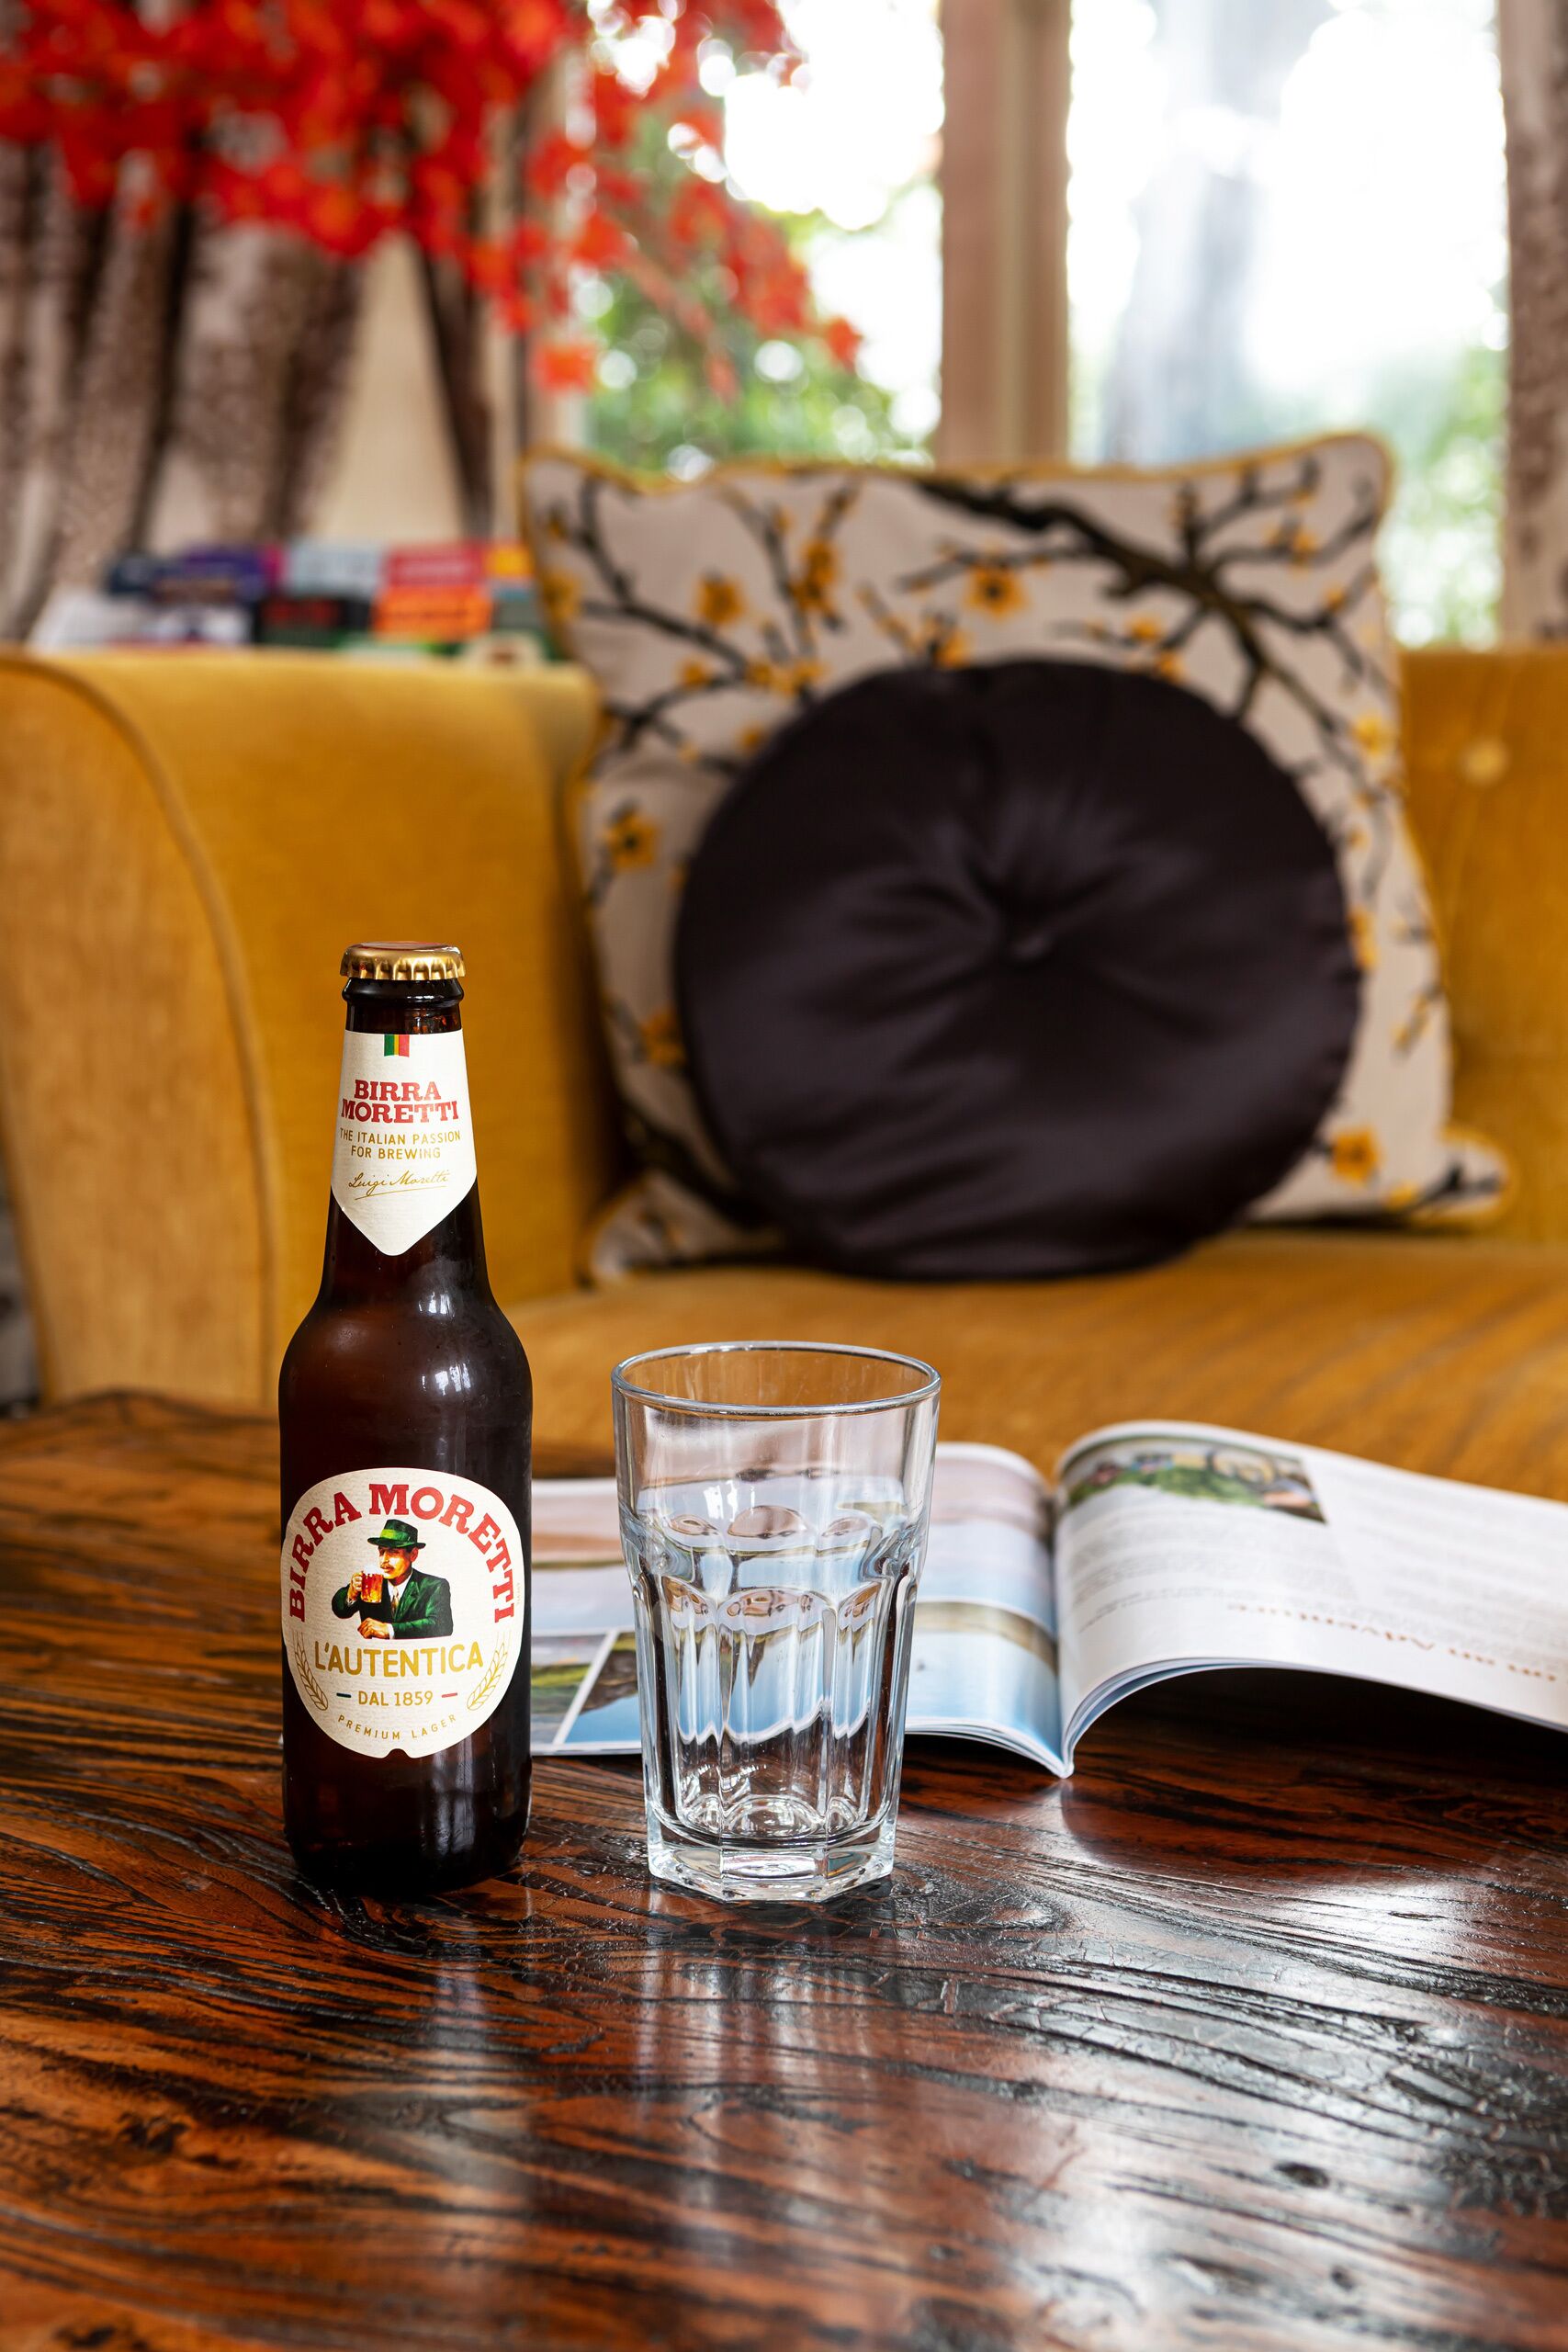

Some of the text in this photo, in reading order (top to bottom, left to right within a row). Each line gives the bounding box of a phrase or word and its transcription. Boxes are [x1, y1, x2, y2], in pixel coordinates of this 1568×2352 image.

[355, 1080, 441, 1102] BIRRA
[342, 1098, 458, 1123] MORETTI
[340, 1127, 461, 1146] THE ITALIAN PASSION
[351, 1146, 441, 1160] FOR BREWING
[348, 1171, 389, 1197] Luigi
[288, 1483, 515, 1623] BIRRA MORETTI
[314, 1641, 484, 1678] L'AUTENTICA
[358, 1690, 434, 1707] DAL 1859
[337, 1713, 457, 1741] PREMIUM LAGER
